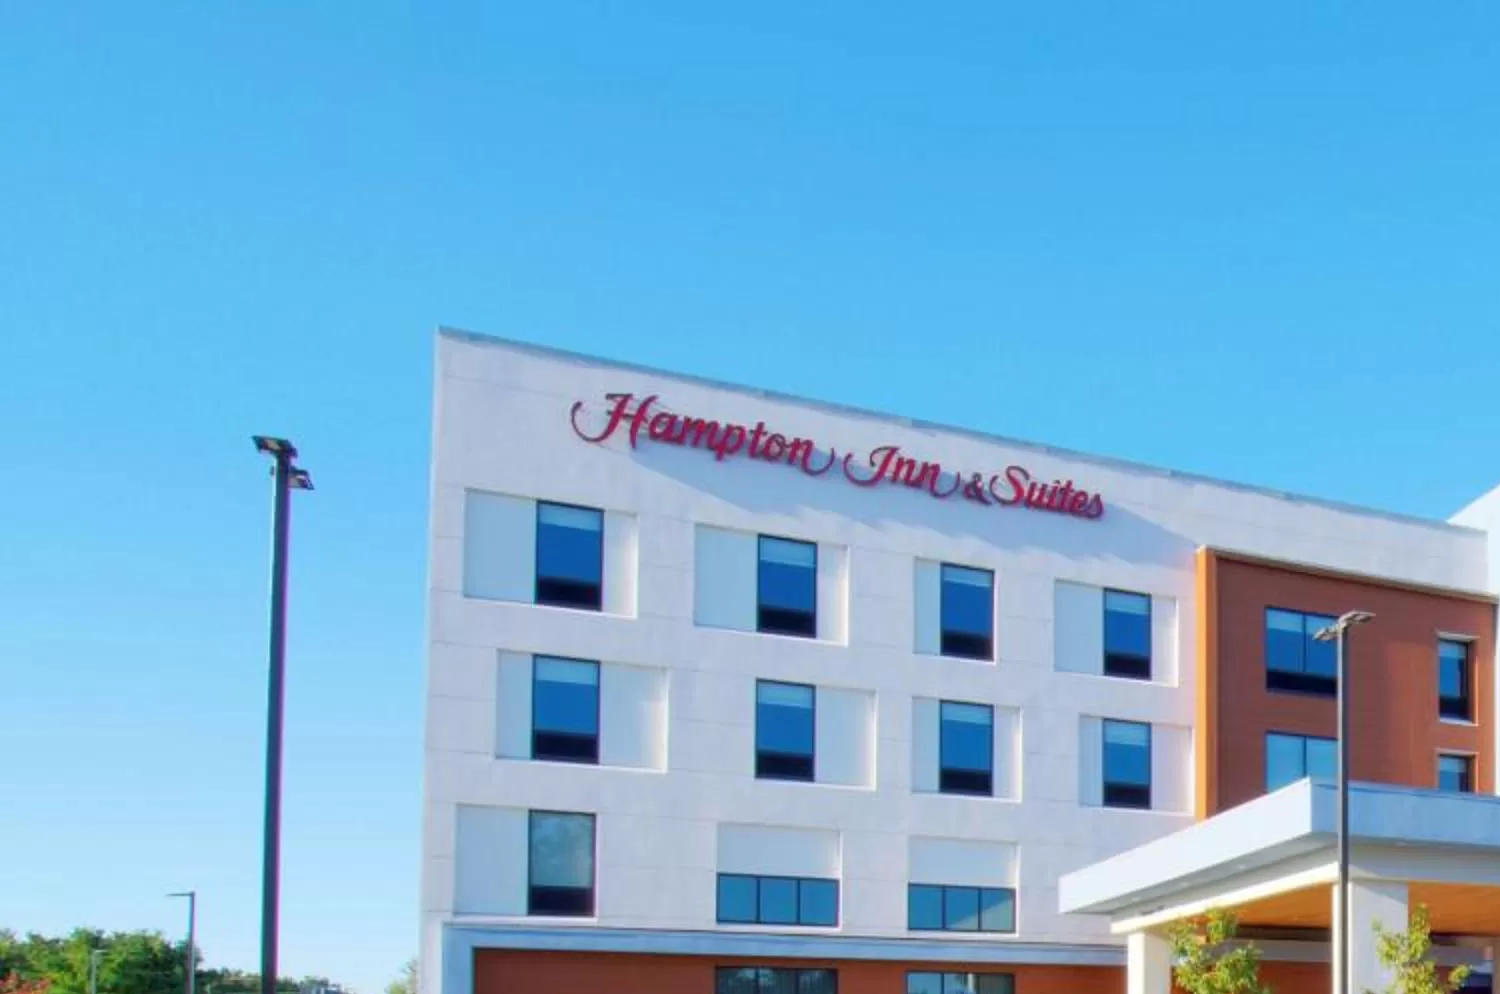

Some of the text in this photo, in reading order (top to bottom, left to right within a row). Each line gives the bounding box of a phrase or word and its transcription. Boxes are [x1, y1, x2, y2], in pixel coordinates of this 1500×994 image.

[570, 392, 836, 476] Hampton
[843, 446, 961, 498] Inn
[990, 465, 1105, 519] Suites
